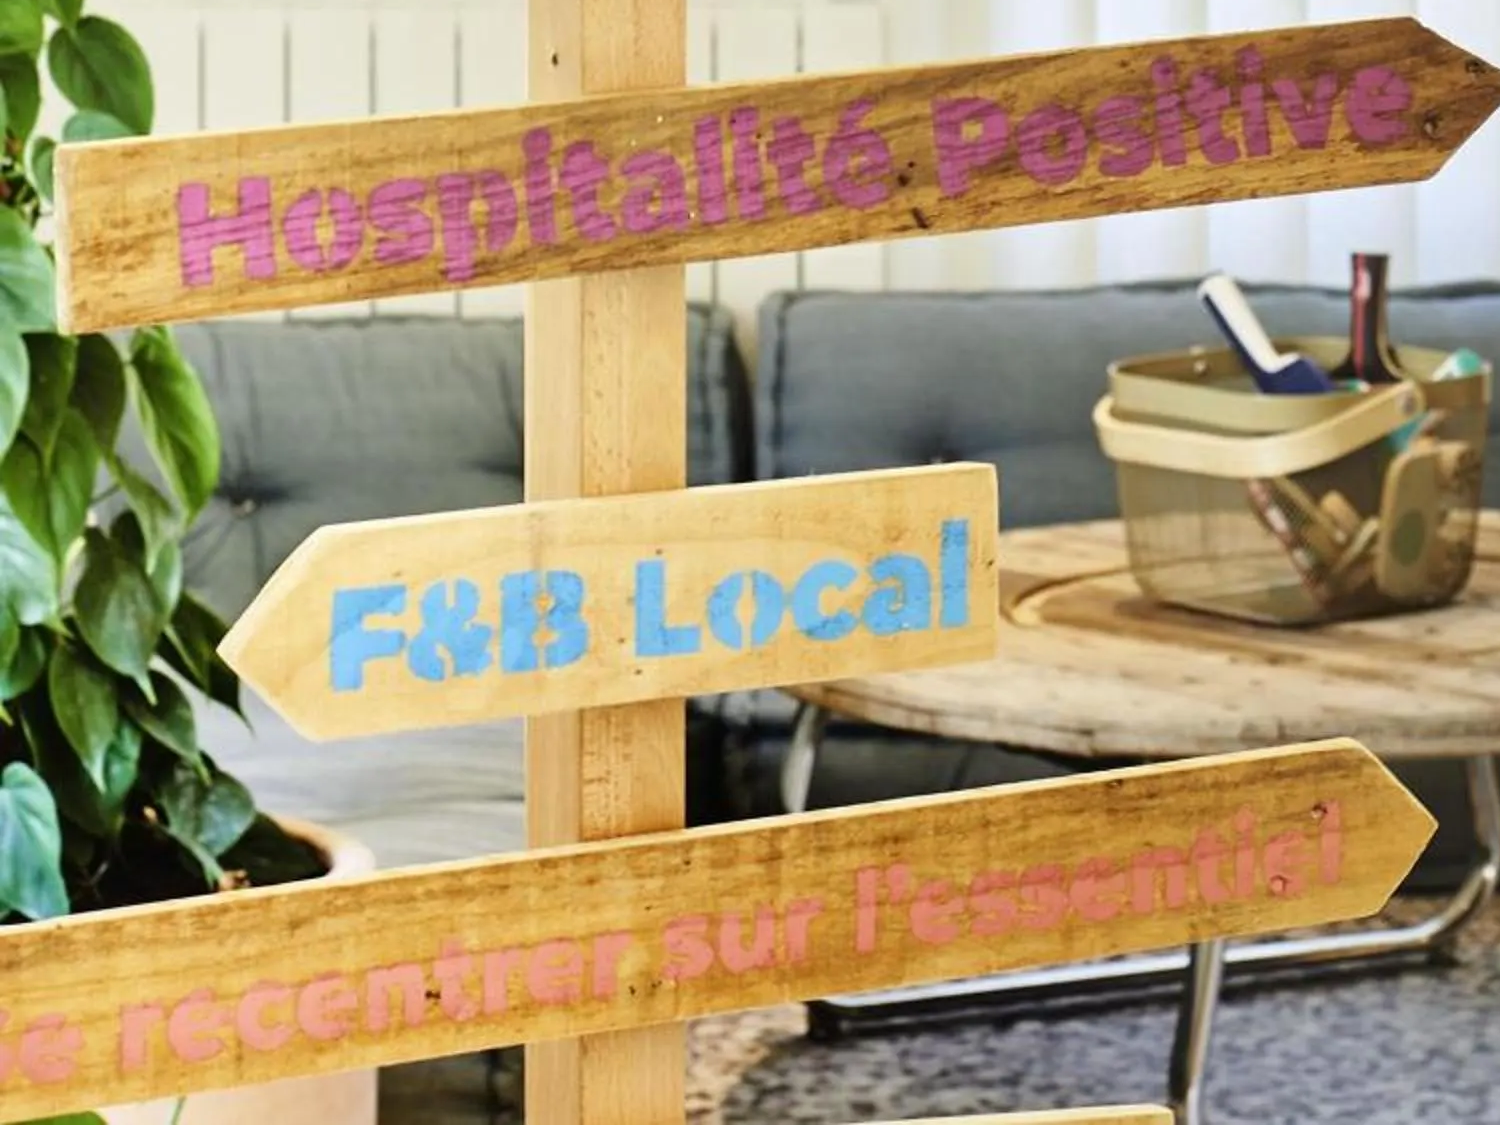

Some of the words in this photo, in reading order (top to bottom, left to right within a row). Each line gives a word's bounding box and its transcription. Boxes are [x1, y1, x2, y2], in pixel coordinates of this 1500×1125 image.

[177, 98, 895, 288] Hospitalité
[931, 45, 1413, 199] Positive
[330, 569, 589, 692] F&B
[635, 518, 970, 659] Local
[118, 930, 634, 1072] recentrer
[660, 896, 823, 982] sur
[854, 799, 1344, 953] l'essentiel
